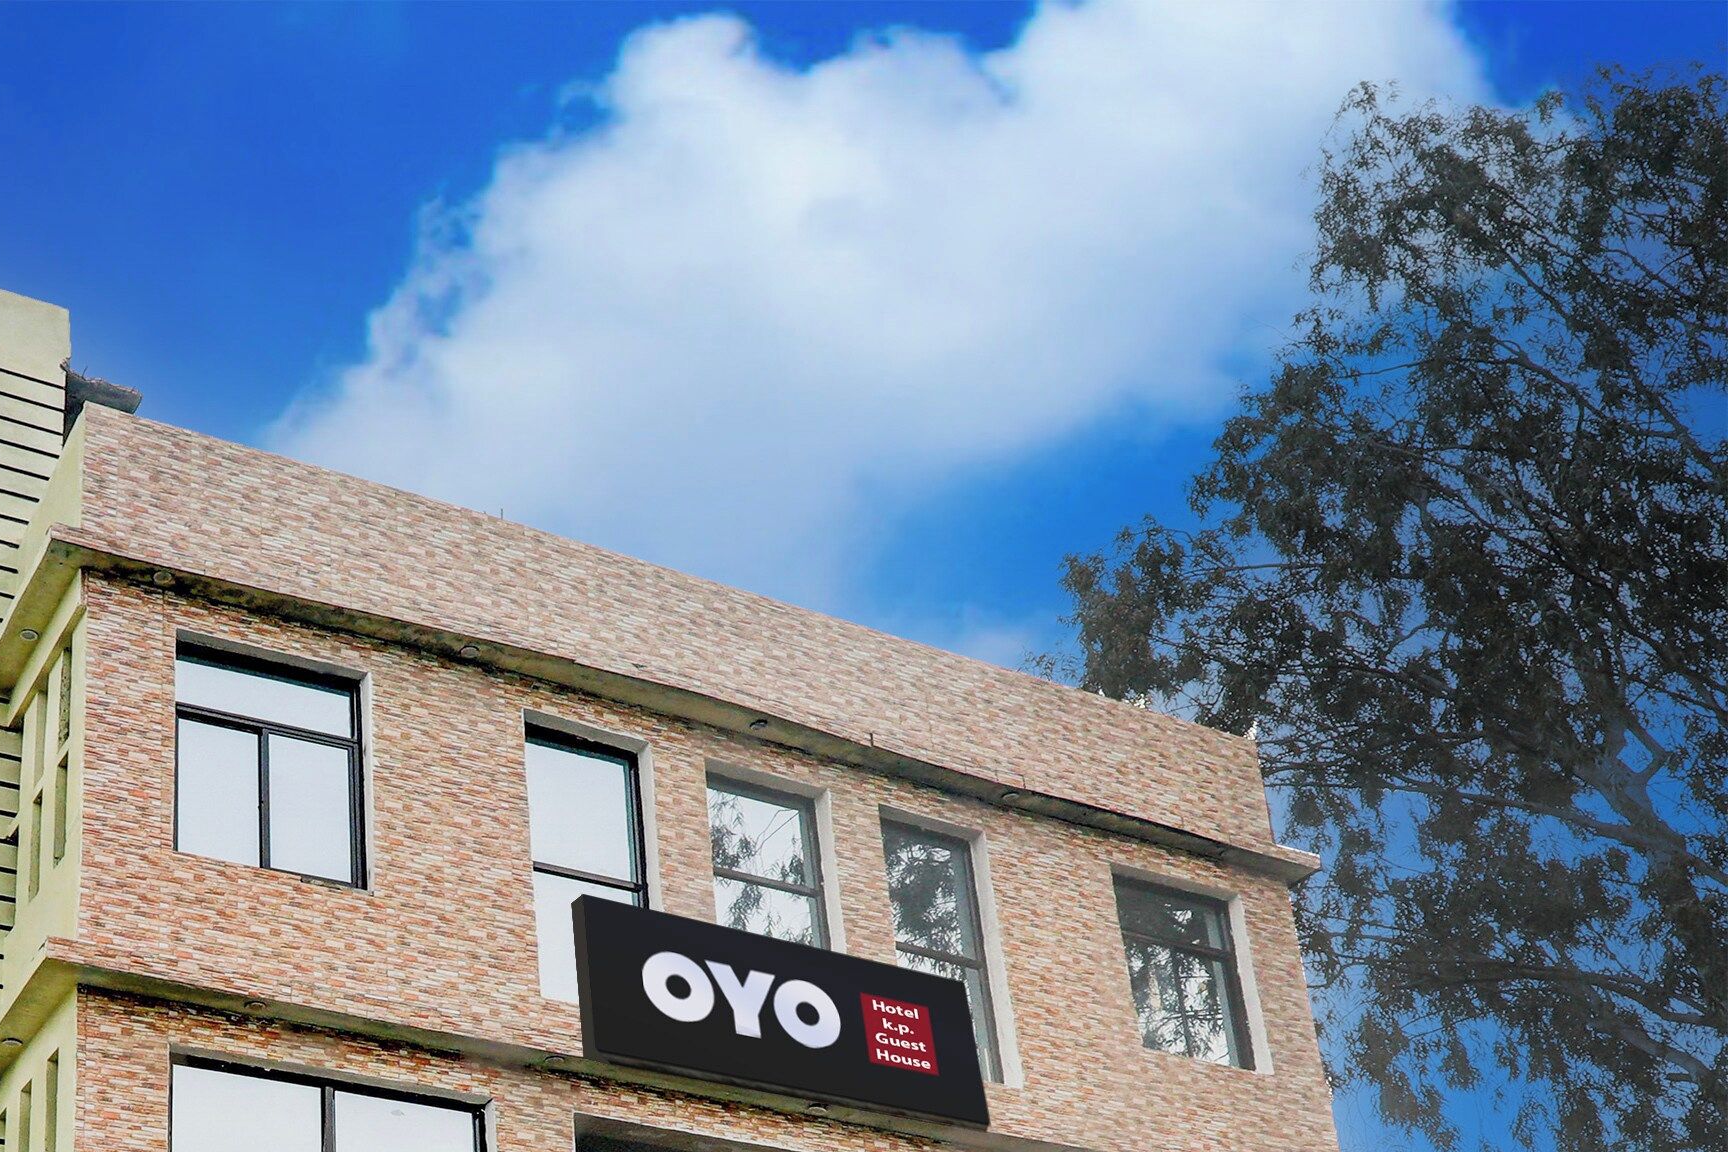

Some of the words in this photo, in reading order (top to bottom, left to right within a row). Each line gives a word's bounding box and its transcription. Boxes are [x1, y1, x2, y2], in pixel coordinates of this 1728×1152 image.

[642, 951, 841, 1049] OYO
[872, 999, 919, 1019] Hotel
[882, 1018, 914, 1035] k.p.
[875, 1032, 926, 1052] Guest
[876, 1048, 931, 1069] House
